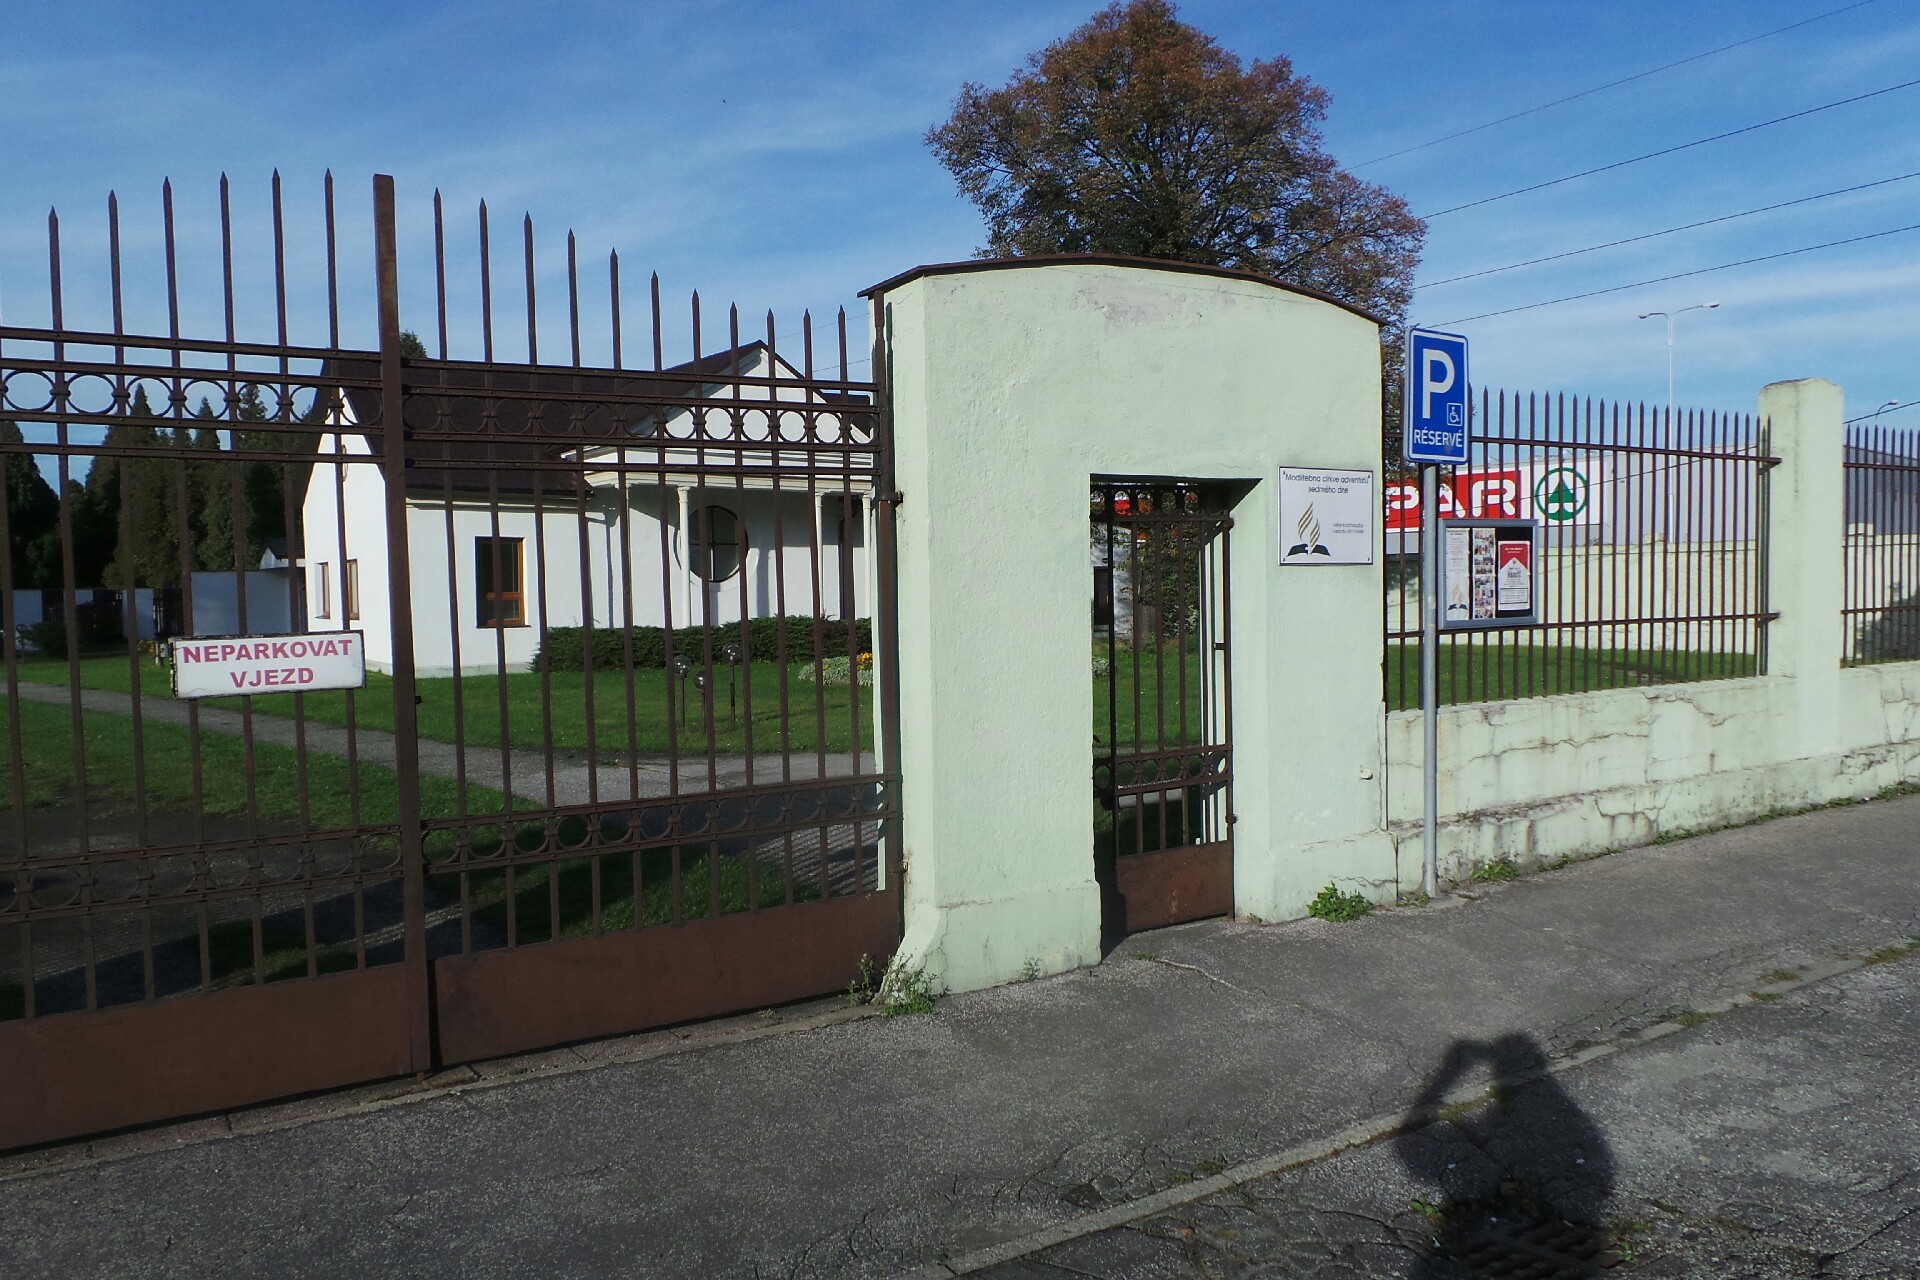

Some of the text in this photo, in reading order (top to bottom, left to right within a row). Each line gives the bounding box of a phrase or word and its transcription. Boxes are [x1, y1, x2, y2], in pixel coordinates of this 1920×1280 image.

[1422, 348, 1455, 419] P
[1413, 426, 1463, 448] RÉSERVÉ
[1285, 473, 1321, 483] Modlitebna
[1308, 485, 1349, 494] sedmého dne
[1386, 479, 1515, 520] PAR
[182, 639, 353, 664] NEPARKOVAT
[229, 667, 314, 688] VJEZD
